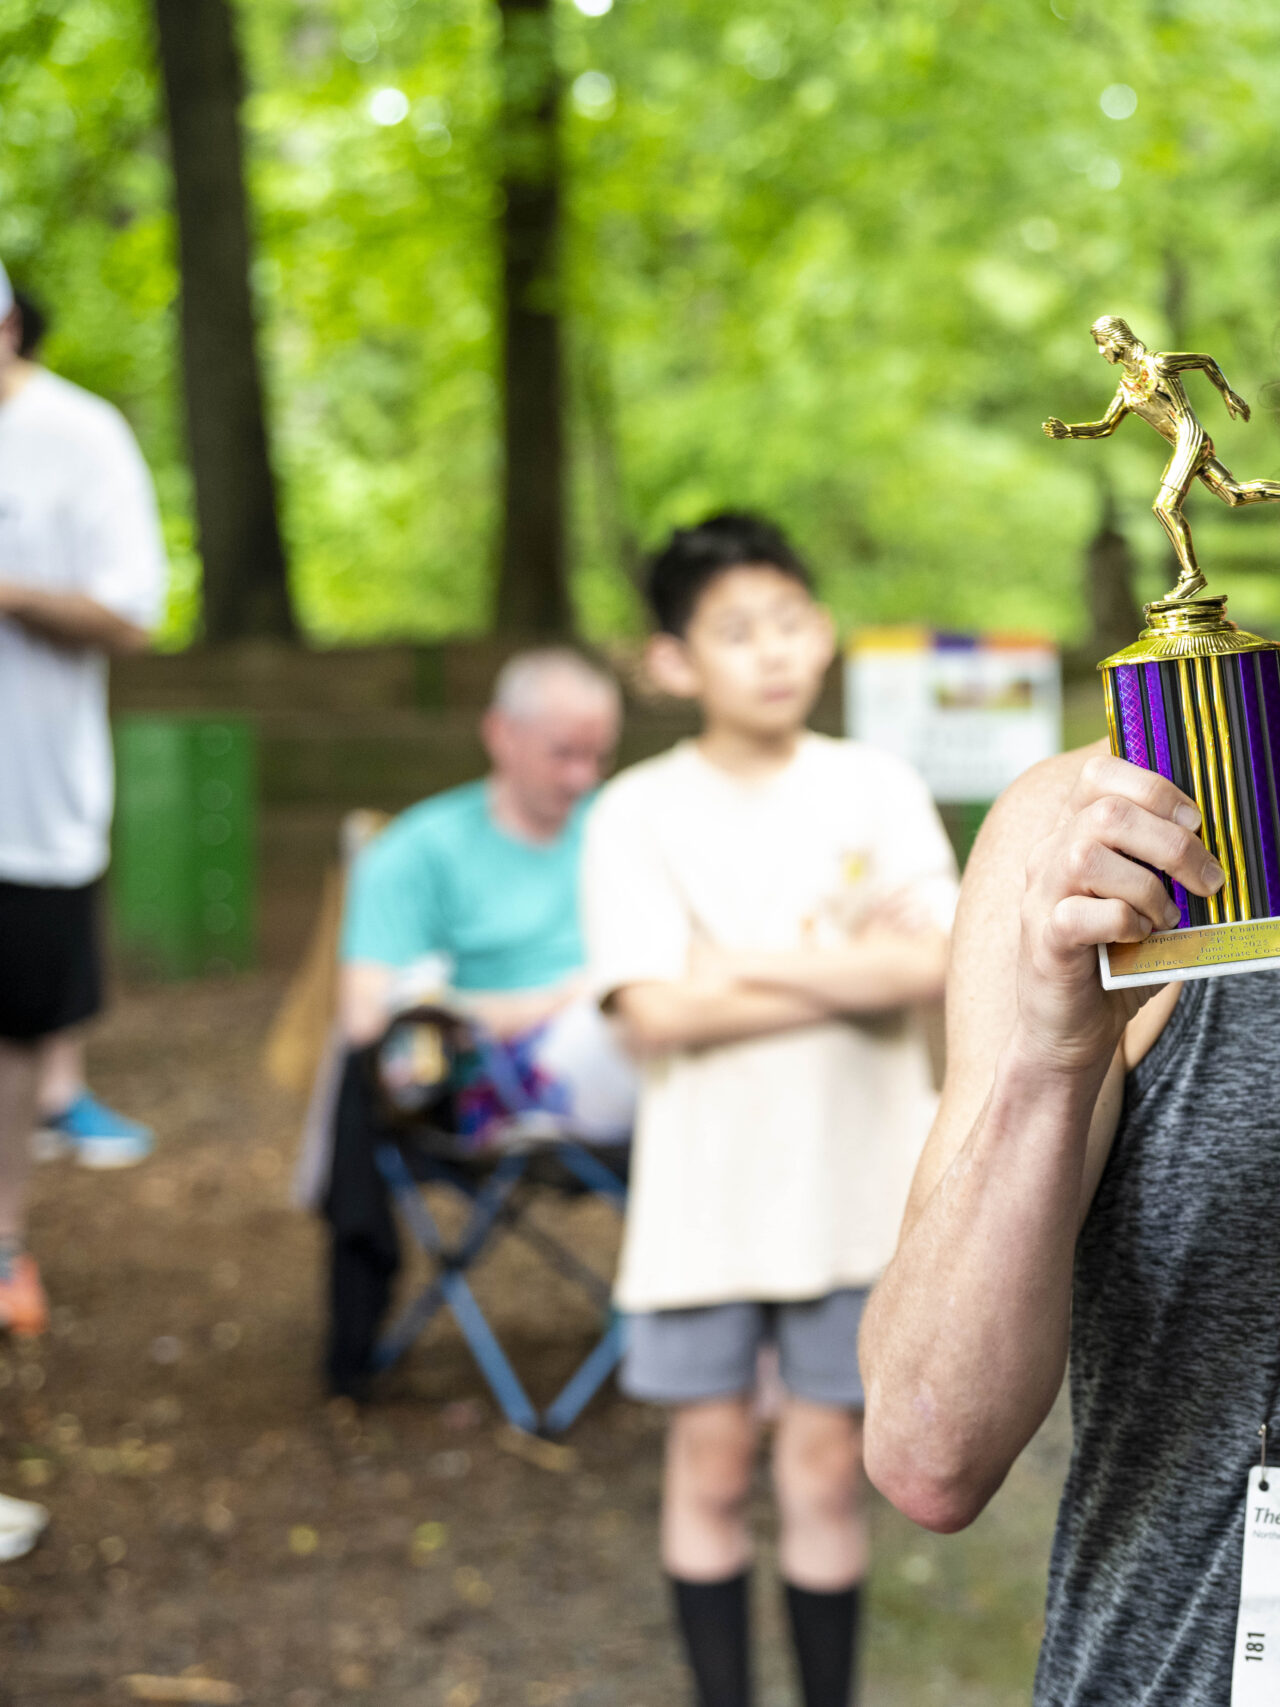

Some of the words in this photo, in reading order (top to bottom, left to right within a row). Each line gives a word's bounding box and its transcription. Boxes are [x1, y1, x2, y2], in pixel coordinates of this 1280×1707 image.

[1199, 929, 1226, 938] Team
[1229, 933, 1256, 942] Race
[1200, 945, 1224, 954] June
[1155, 959, 1184, 967] Place
[1196, 950, 1251, 961] Corporate
[1245, 1632, 1265, 1662] 181
